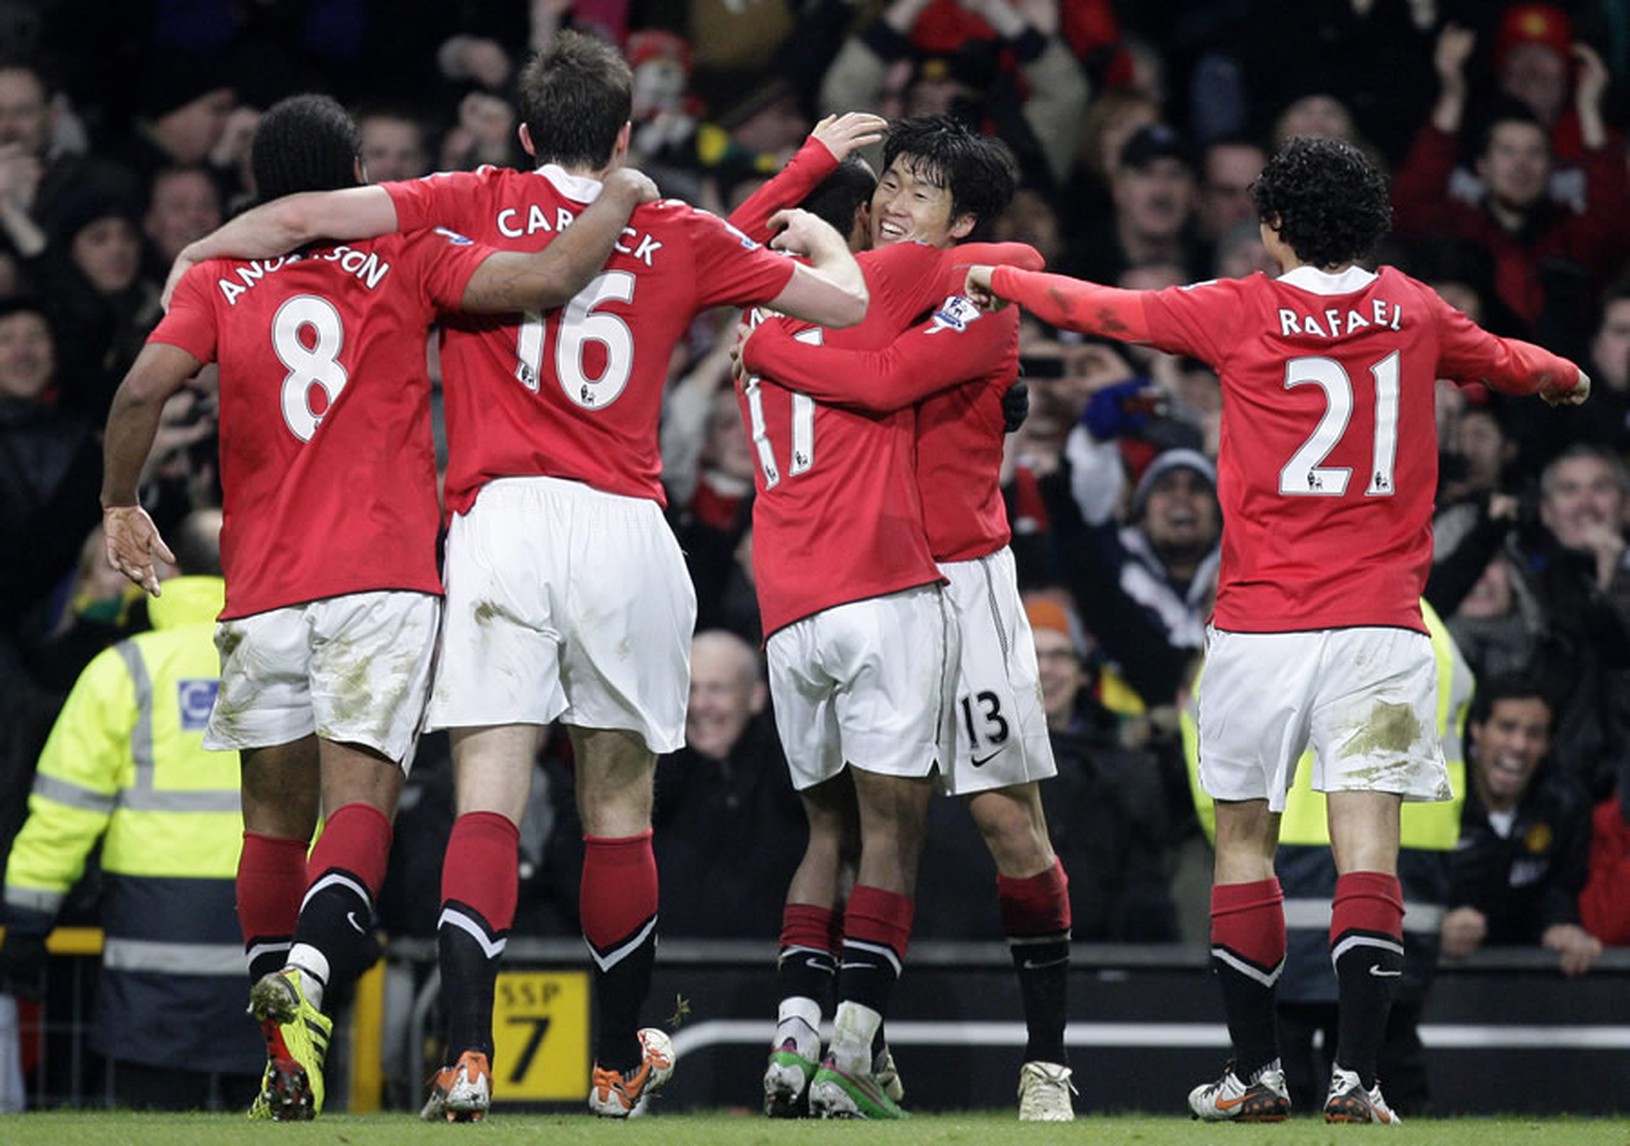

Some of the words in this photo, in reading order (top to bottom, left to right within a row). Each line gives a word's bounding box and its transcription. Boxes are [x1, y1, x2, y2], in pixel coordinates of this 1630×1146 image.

[497, 204, 664, 267] CARCK
[515, 269, 637, 411] 16
[1279, 299, 1402, 338] RAFAEL
[271, 293, 349, 444] 8
[1279, 349, 1401, 497] 21
[961, 690, 1009, 749] 13
[500, 982, 562, 1007] SSP
[506, 1015, 551, 1085] 7
